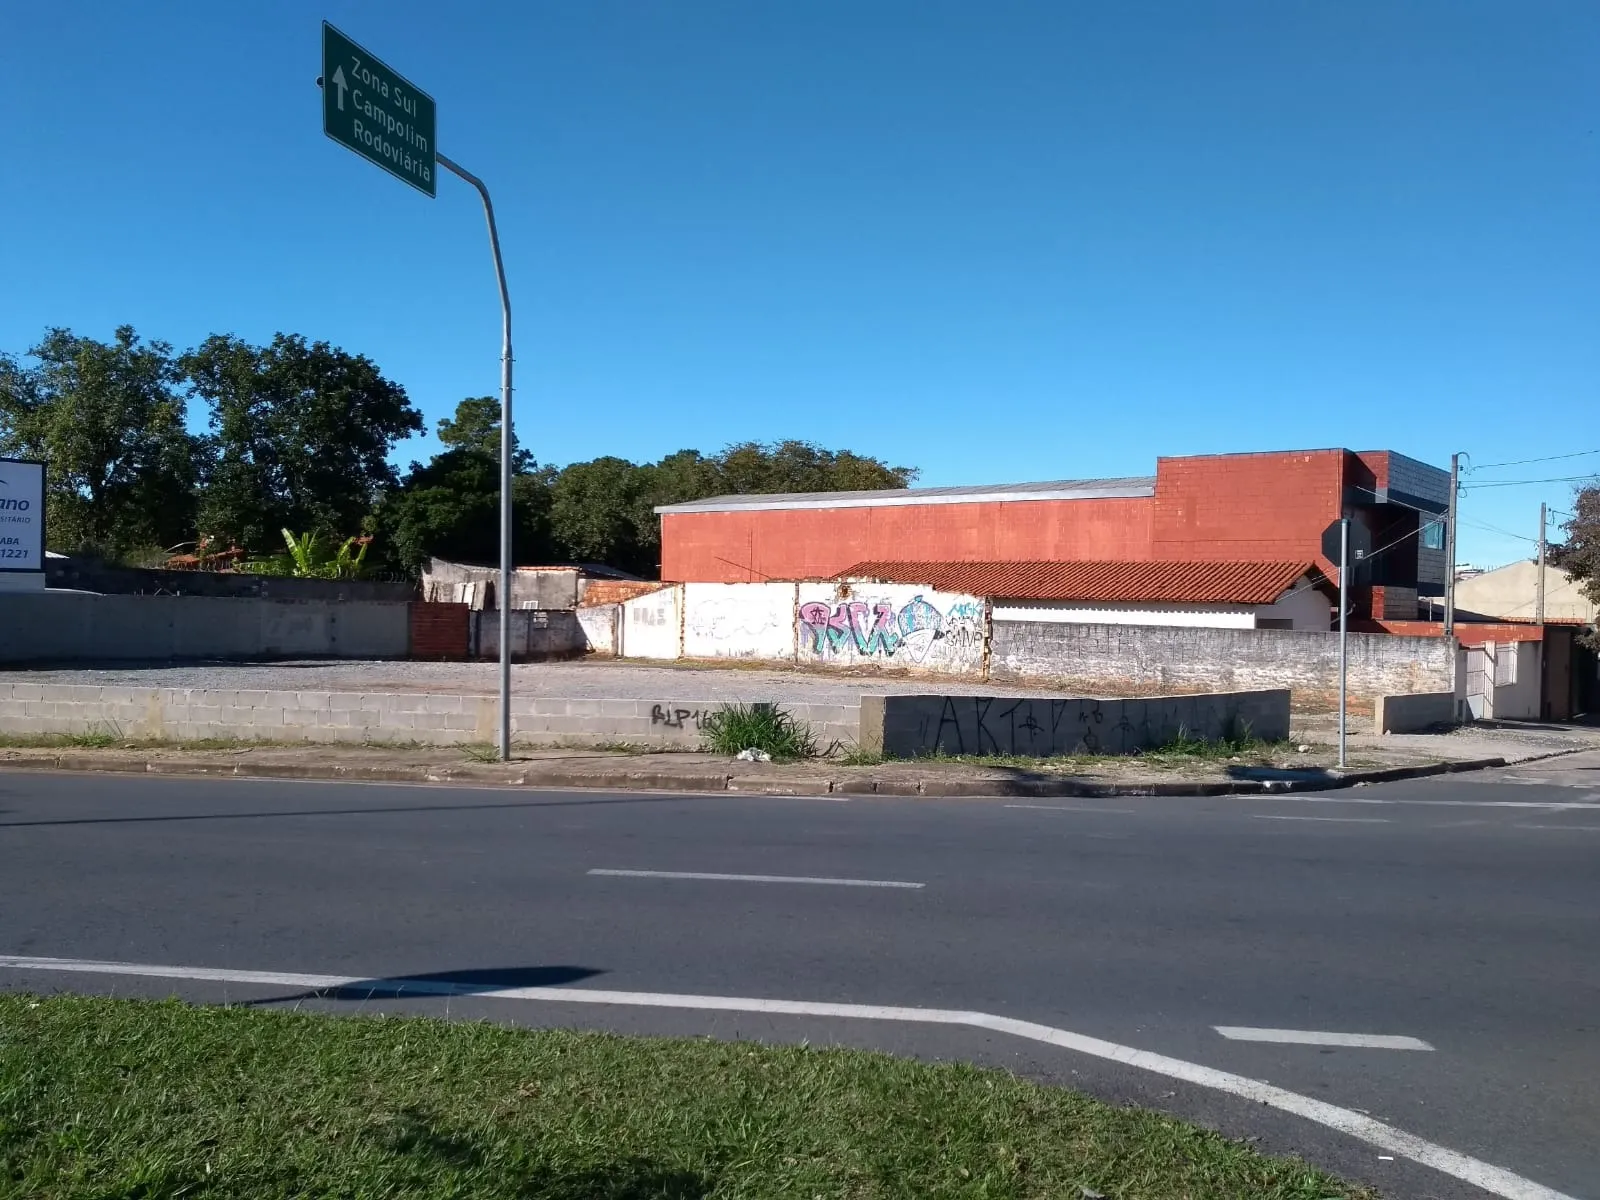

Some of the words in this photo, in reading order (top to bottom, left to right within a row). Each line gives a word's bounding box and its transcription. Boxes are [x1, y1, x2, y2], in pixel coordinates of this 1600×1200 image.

[352, 55, 389, 98] Zona
[394, 87, 417, 118] Sul
[353, 89, 428, 153] Campolim
[353, 118, 430, 182] Rodoviária
